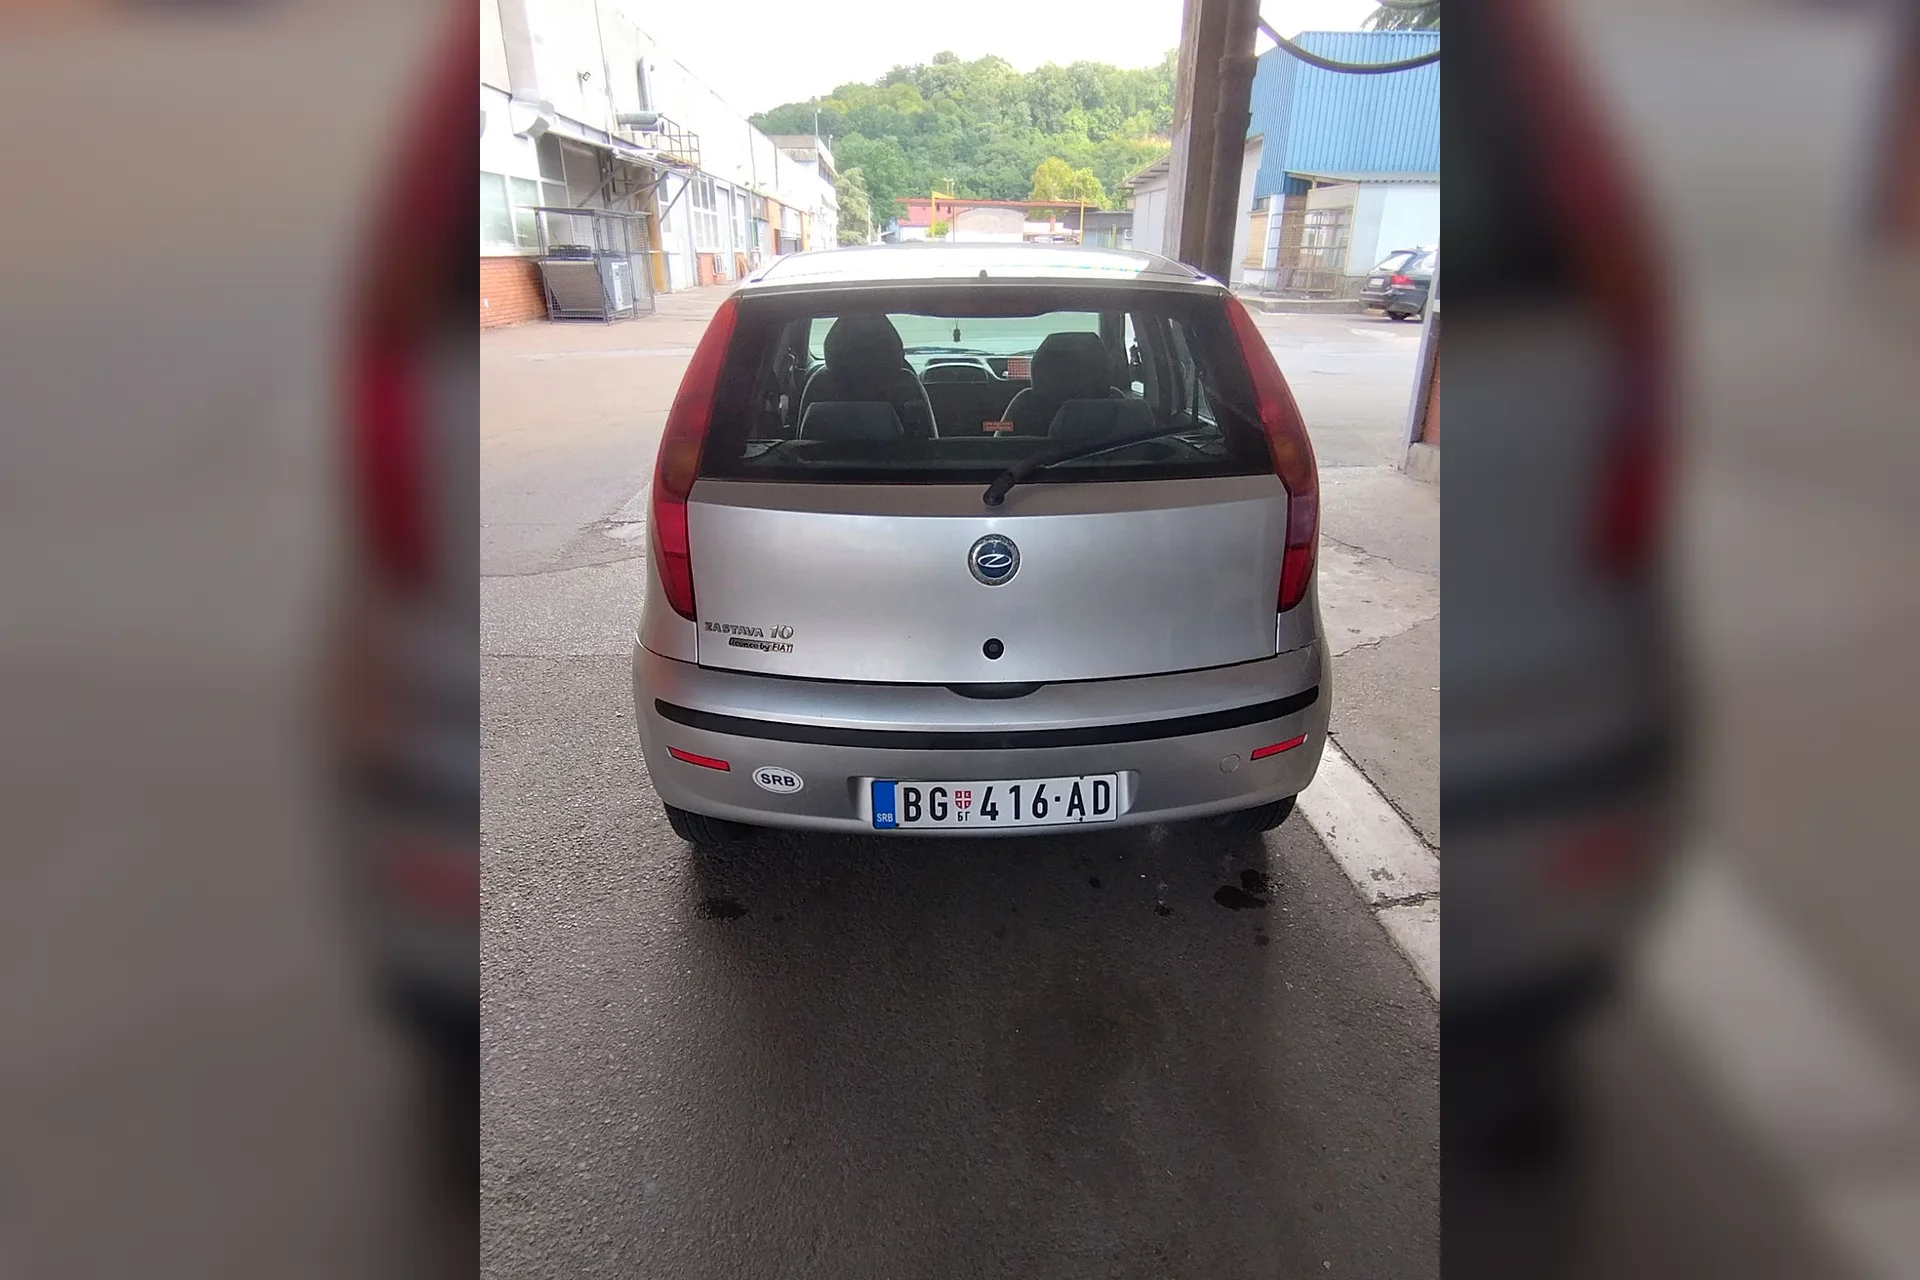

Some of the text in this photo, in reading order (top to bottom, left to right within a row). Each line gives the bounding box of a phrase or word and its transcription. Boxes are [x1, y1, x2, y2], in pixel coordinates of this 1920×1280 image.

[704, 621, 794, 640] ZASTAVA 10
[760, 642, 770, 652] by
[772, 643, 792, 653] FIAT
[760, 773, 796, 787] SRB
[903, 786, 948, 823] BG
[876, 812, 894, 823] SRB
[957, 811, 971, 822] БГ
